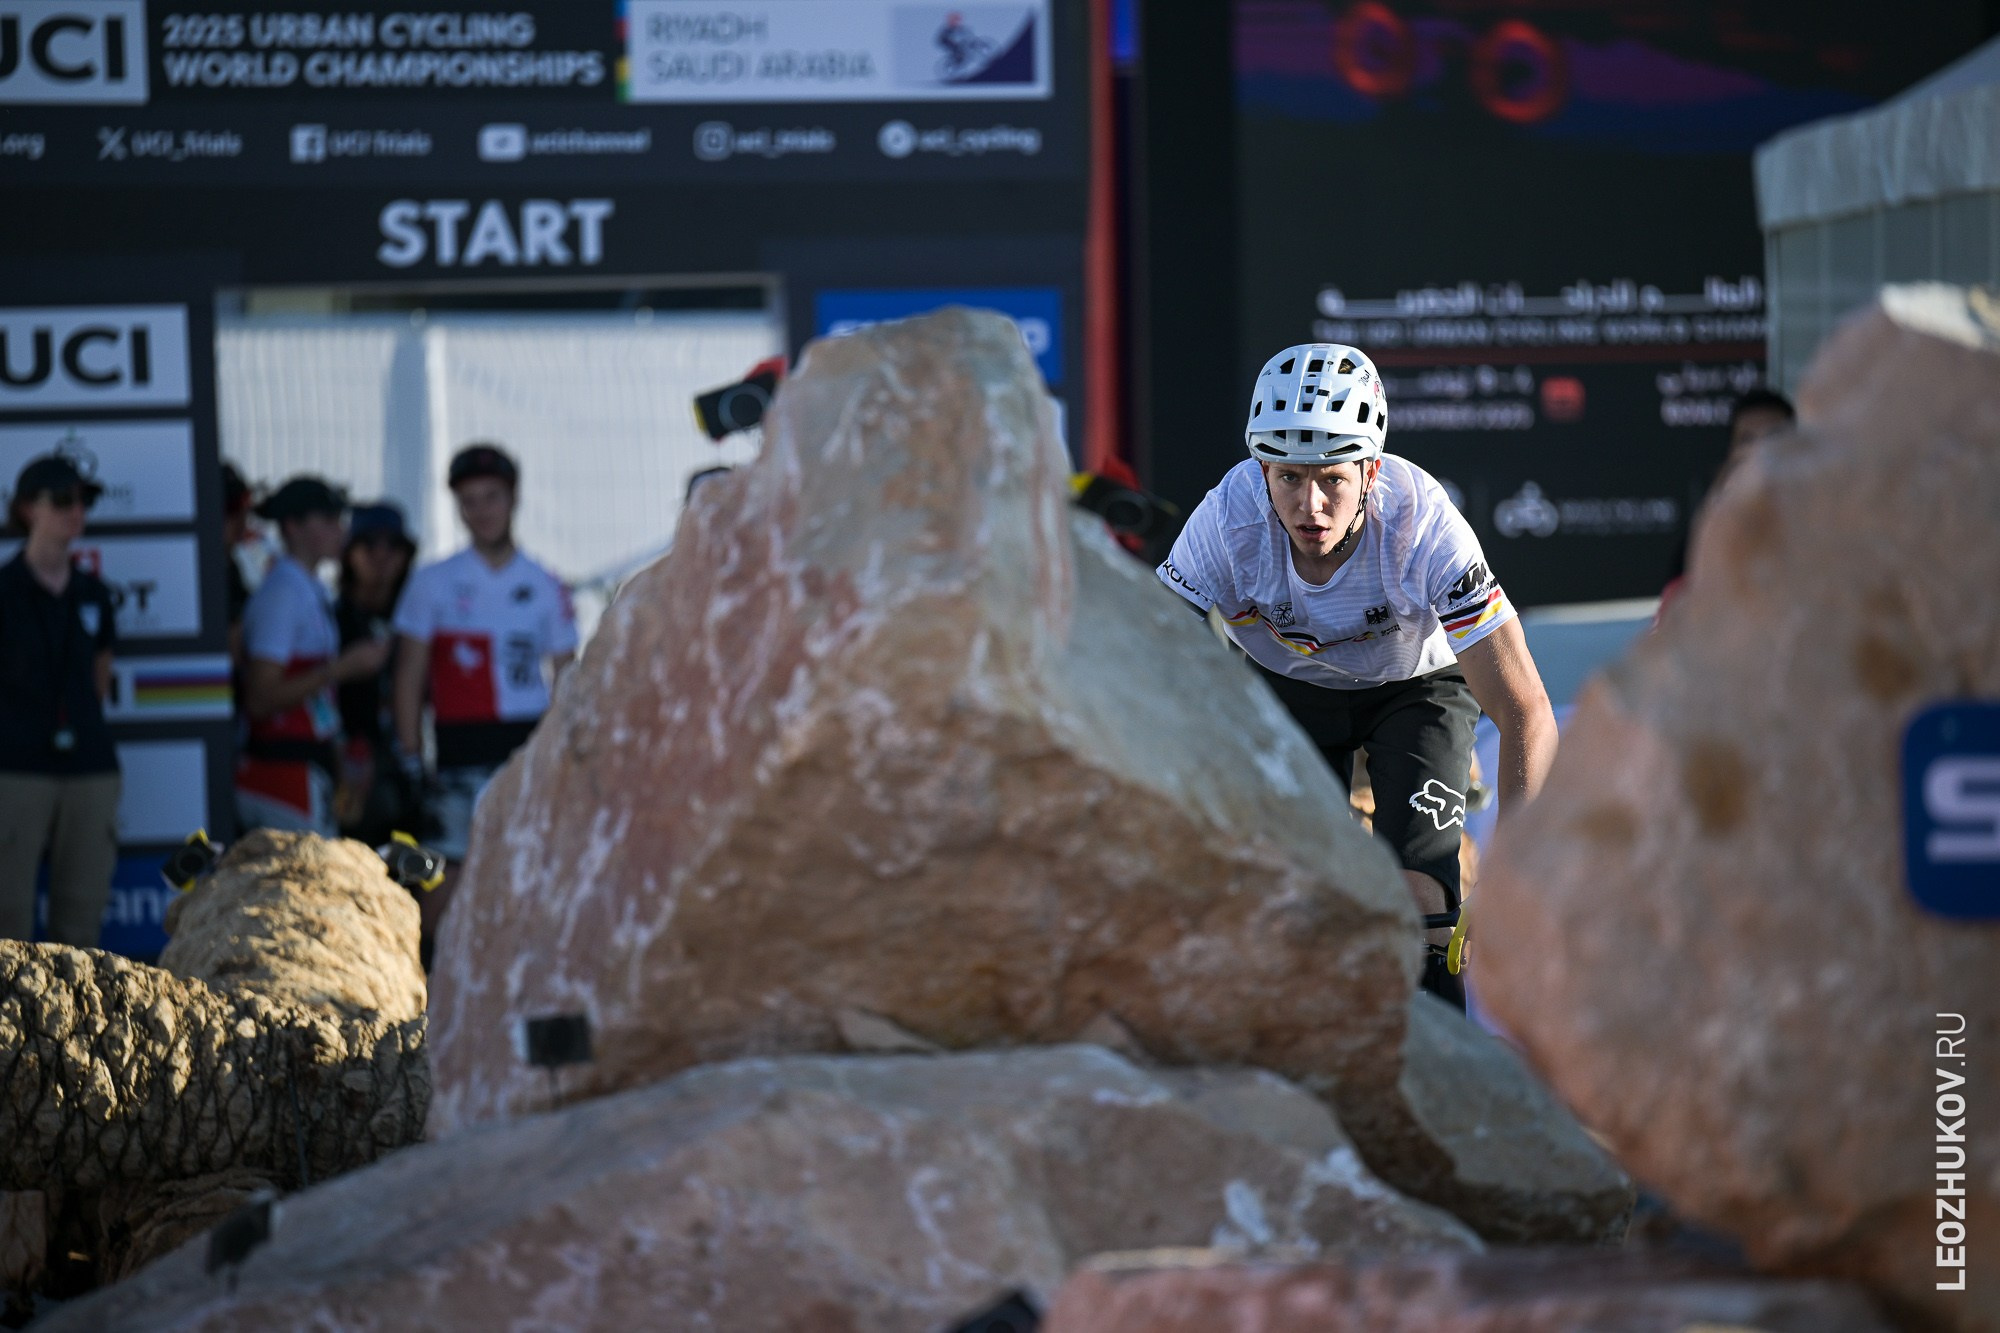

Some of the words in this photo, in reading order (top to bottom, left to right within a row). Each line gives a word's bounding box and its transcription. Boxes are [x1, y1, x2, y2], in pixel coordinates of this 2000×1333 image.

[163, 13, 245, 48] 2025
[251, 12, 375, 48] URBAN
[379, 12, 536, 48] CYCLING
[646, 12, 769, 45] RIYADH
[163, 51, 300, 87] WORLD
[303, 50, 606, 87] CHAMPIONSHIPS
[647, 49, 751, 84] SAUDI
[755, 49, 878, 82] ARABIA
[379, 199, 614, 267] START
[0, 325, 151, 388] UCI
